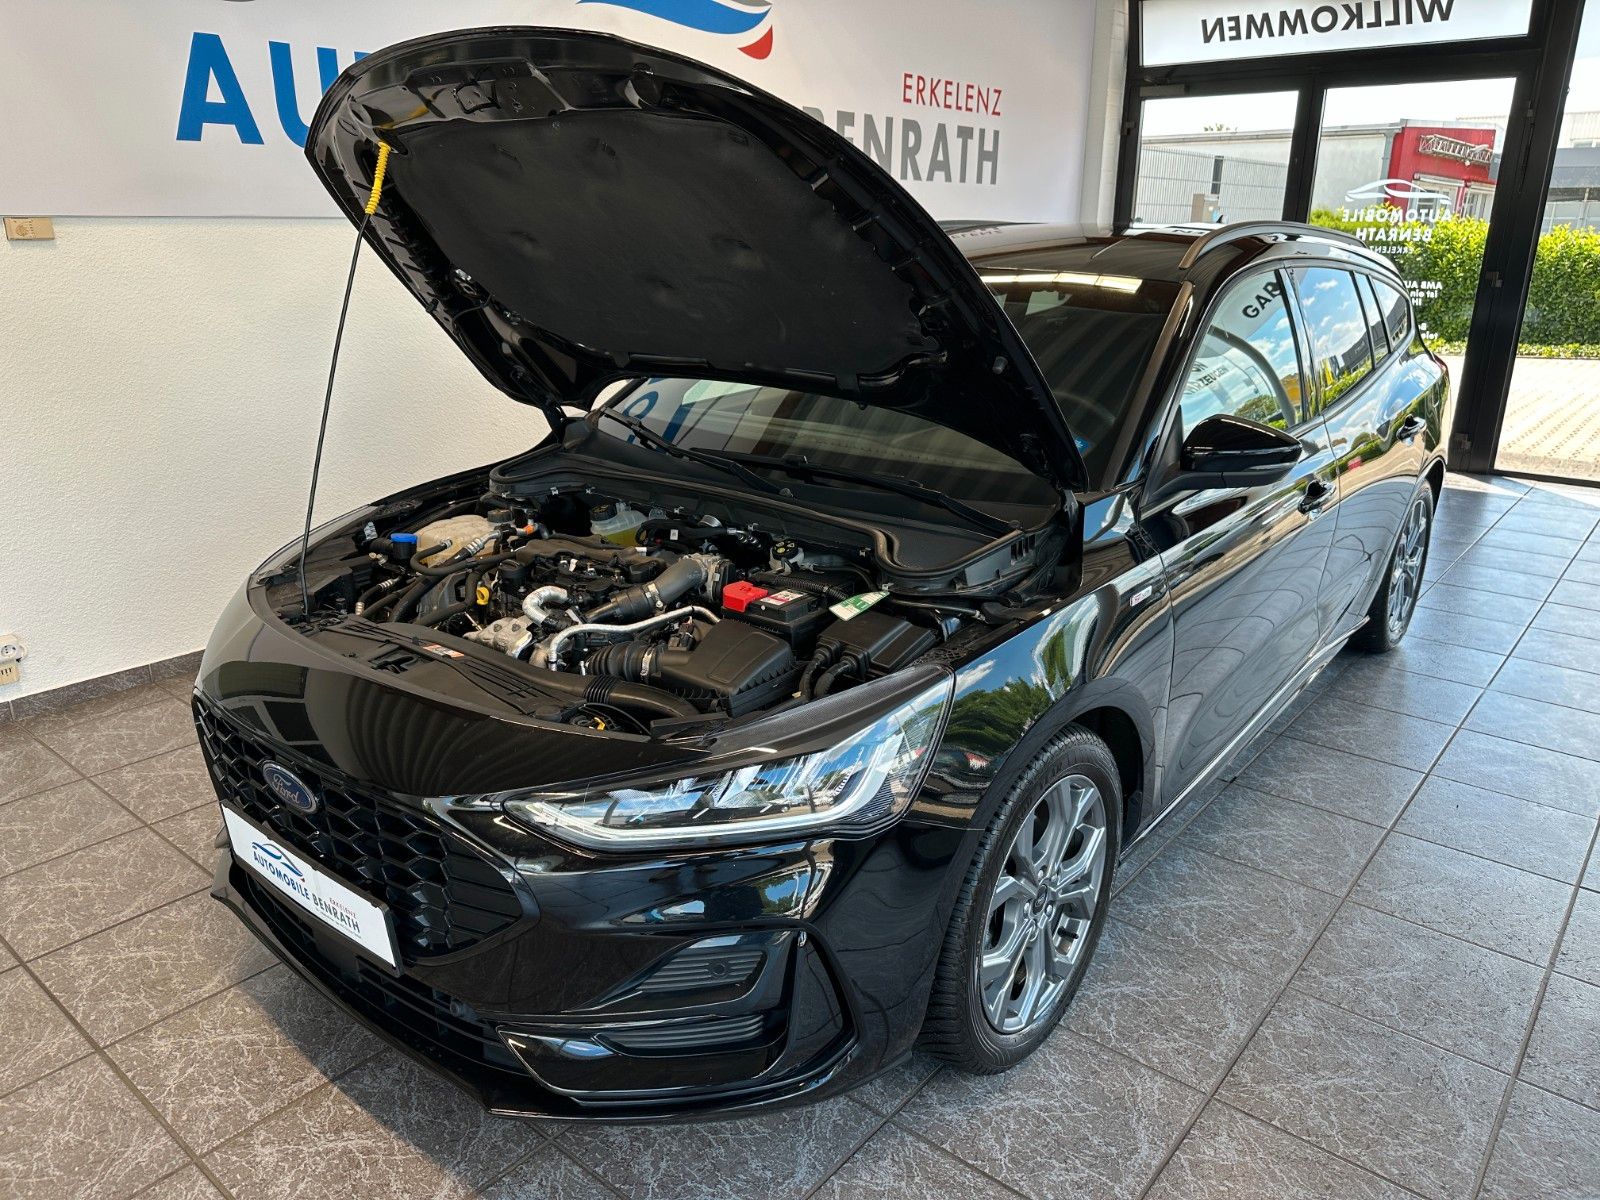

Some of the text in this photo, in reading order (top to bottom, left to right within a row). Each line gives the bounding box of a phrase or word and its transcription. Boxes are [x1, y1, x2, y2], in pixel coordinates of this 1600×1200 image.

[176, 32, 374, 148] AU
[903, 73, 1002, 116] ERKELENZ
[273, 774, 301, 804] Ford
[253, 850, 310, 901] AUTOMOBILE
[311, 893, 361, 933] BENRATH
